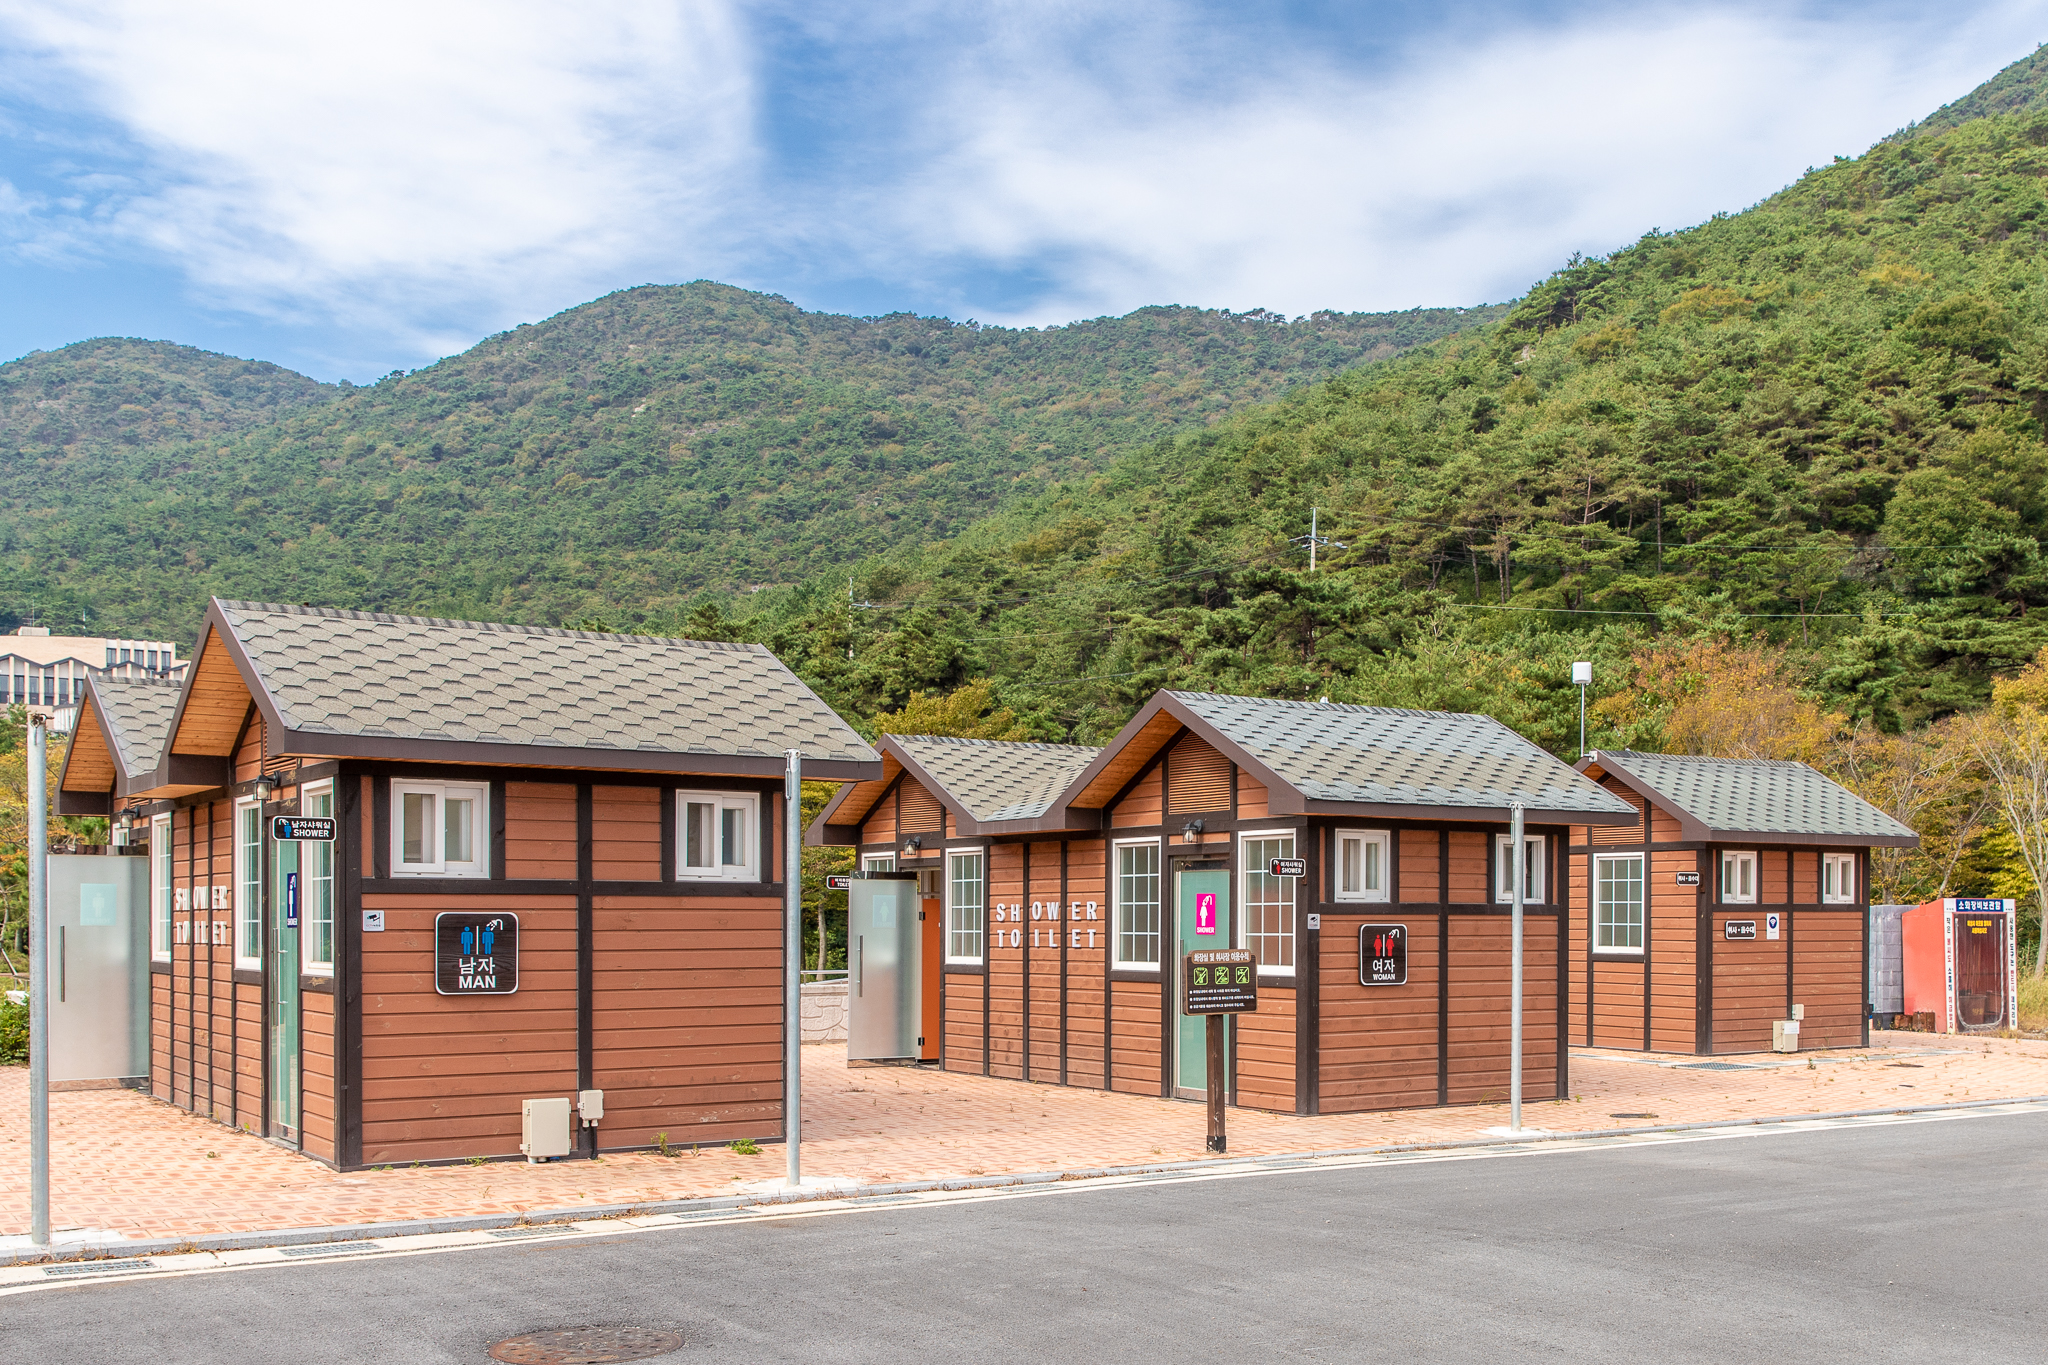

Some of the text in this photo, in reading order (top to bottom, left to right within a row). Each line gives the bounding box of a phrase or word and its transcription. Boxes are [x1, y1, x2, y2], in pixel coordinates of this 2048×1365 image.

[291, 820, 331, 830] 남자샤워실
[293, 829, 329, 838] SHOWER
[175, 885, 228, 911] SHOWER
[1958, 900, 2001, 910] 소화장비보관함
[996, 901, 1098, 921] SHOWER
[176, 921, 227, 944] TOILET
[997, 929, 1097, 948] TOILET
[459, 957, 496, 975] 남자
[1372, 958, 1395, 973] 여자
[459, 975, 496, 989] MAN
[1372, 973, 1396, 981] WOMAN
